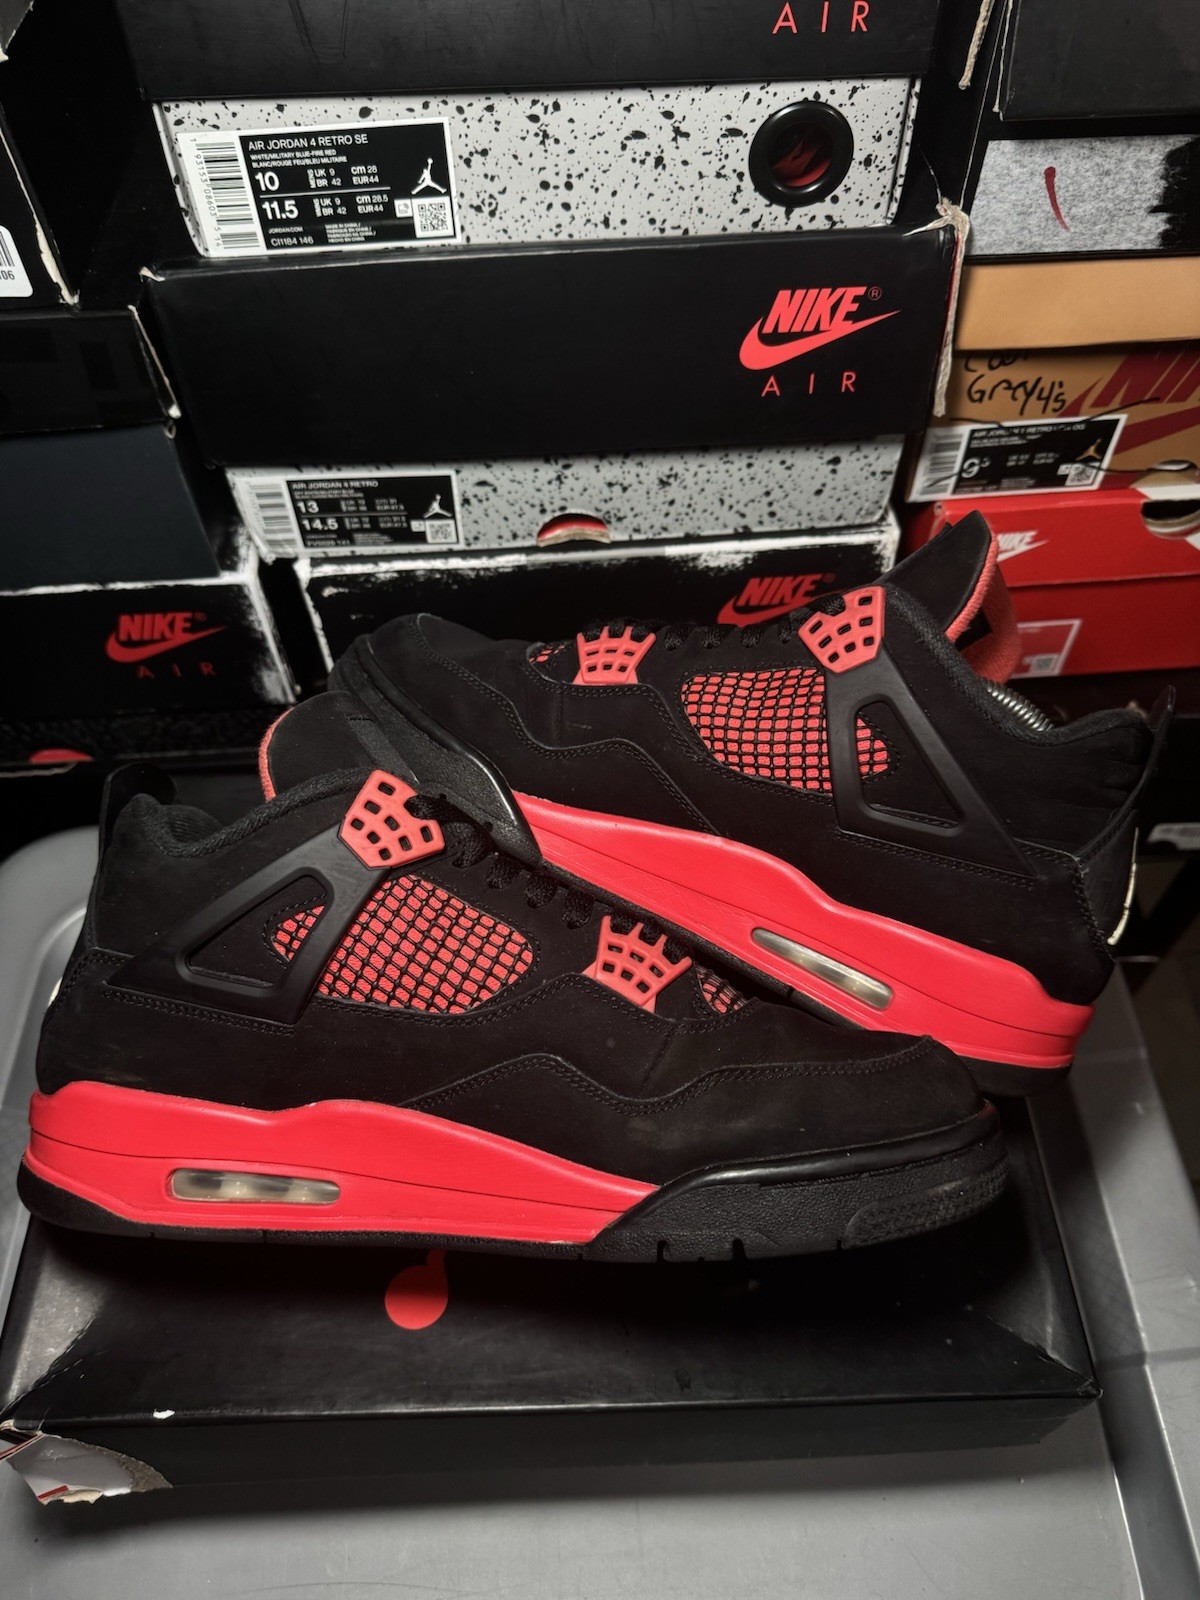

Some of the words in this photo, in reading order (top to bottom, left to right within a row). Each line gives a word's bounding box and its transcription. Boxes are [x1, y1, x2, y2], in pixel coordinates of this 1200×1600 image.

[771, 0, 870, 34] AIR
[249, 140, 265, 151] AIR
[267, 138, 308, 150] JORDAN
[310, 137, 316, 146] 4
[318, 135, 352, 146] RETRO
[354, 134, 368, 144] SE
[250, 152, 295, 160] WHITE/MILITARY
[314, 169, 327, 177] UK
[329, 168, 335, 176] 9
[367, 165, 378, 174] 28
[255, 171, 280, 191] 10
[316, 179, 328, 188] BR
[331, 178, 342, 186] 42
[321, 198, 332, 207] UK
[335, 198, 341, 206] 9
[372, 195, 389, 203] 28.5
[262, 200, 299, 220] 11.5
[322, 208, 334, 216] BR
[337, 207, 347, 215] 42
[761, 286, 868, 334] NIKE
[760, 371, 857, 398] AIR
[297, 500, 320, 514] 13
[303, 518, 339, 531] 14.5
[735, 573, 823, 607] NIKE
[119, 611, 192, 641] NIKE
[137, 661, 216, 679] AIR
